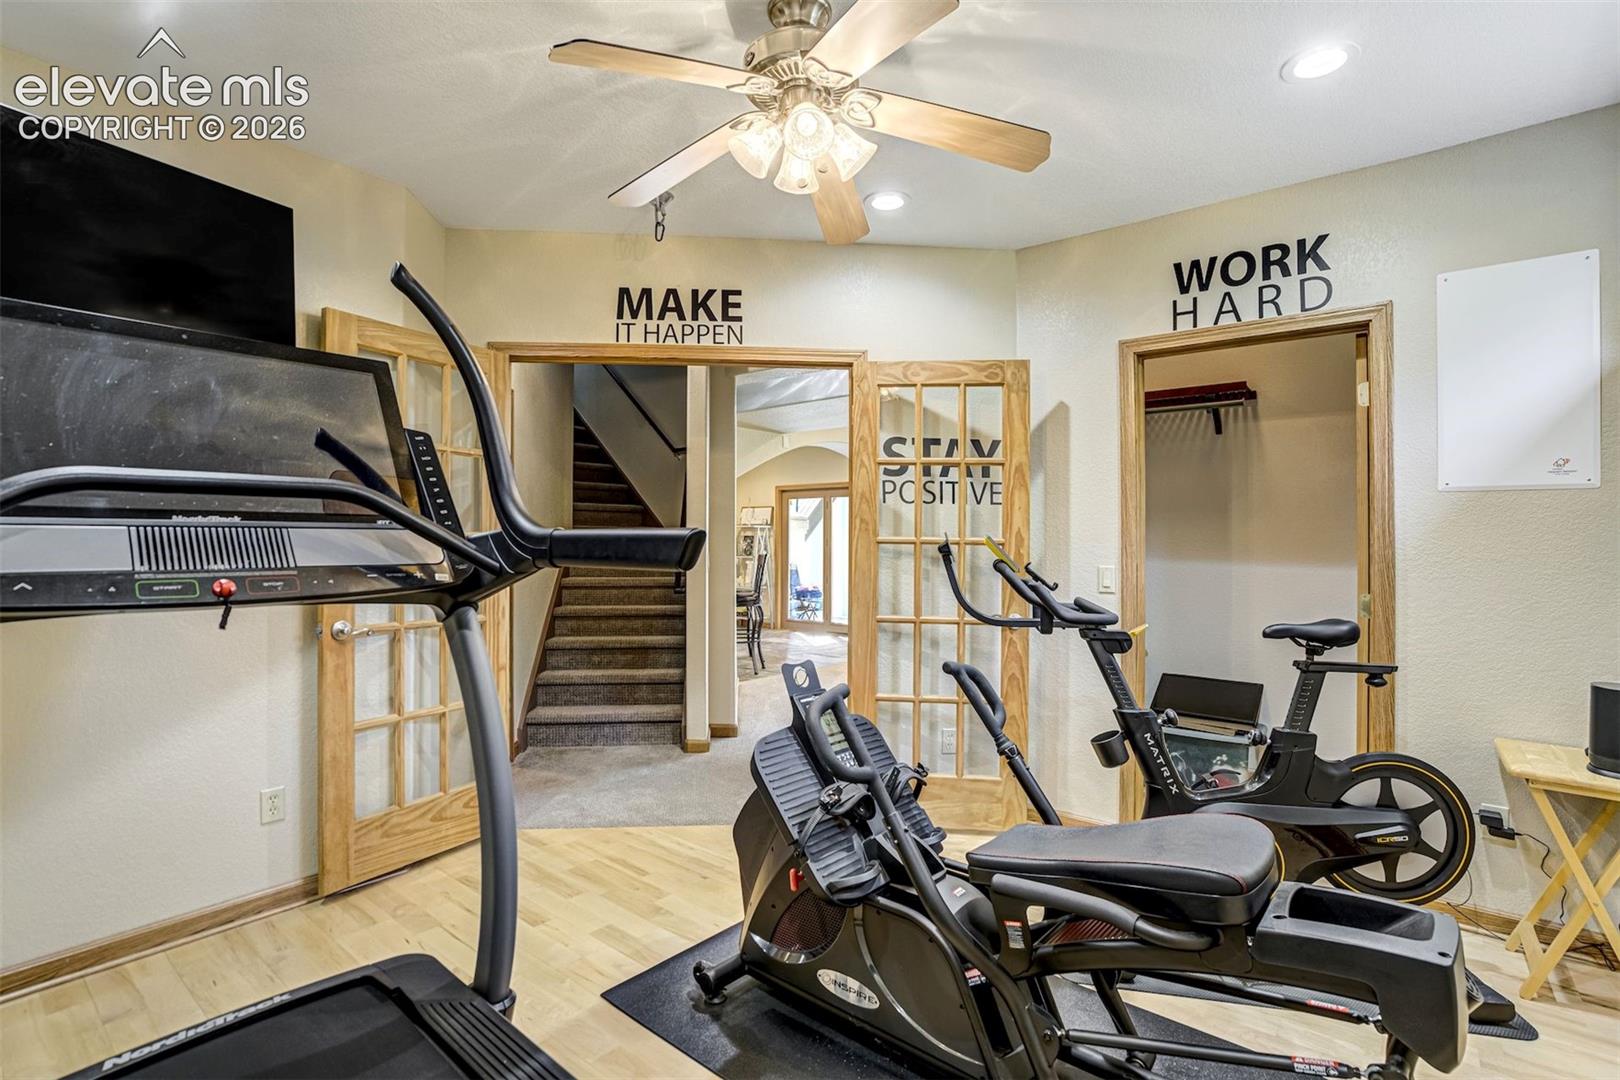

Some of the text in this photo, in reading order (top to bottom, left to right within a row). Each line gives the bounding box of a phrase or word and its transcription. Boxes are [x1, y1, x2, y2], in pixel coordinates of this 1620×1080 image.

[1173, 233, 1331, 295] WORK
[616, 287, 743, 322] MAKE
[1172, 276, 1333, 331] HARD
[616, 322, 743, 344] IT HAPPEN
[882, 436, 1001, 478] STAY
[882, 479, 1002, 505] POSITVE
[1144, 733, 1179, 795] MATRIX
[831, 979, 875, 1005] INSPIRE
[102, 993, 292, 1071] NordicTrack
